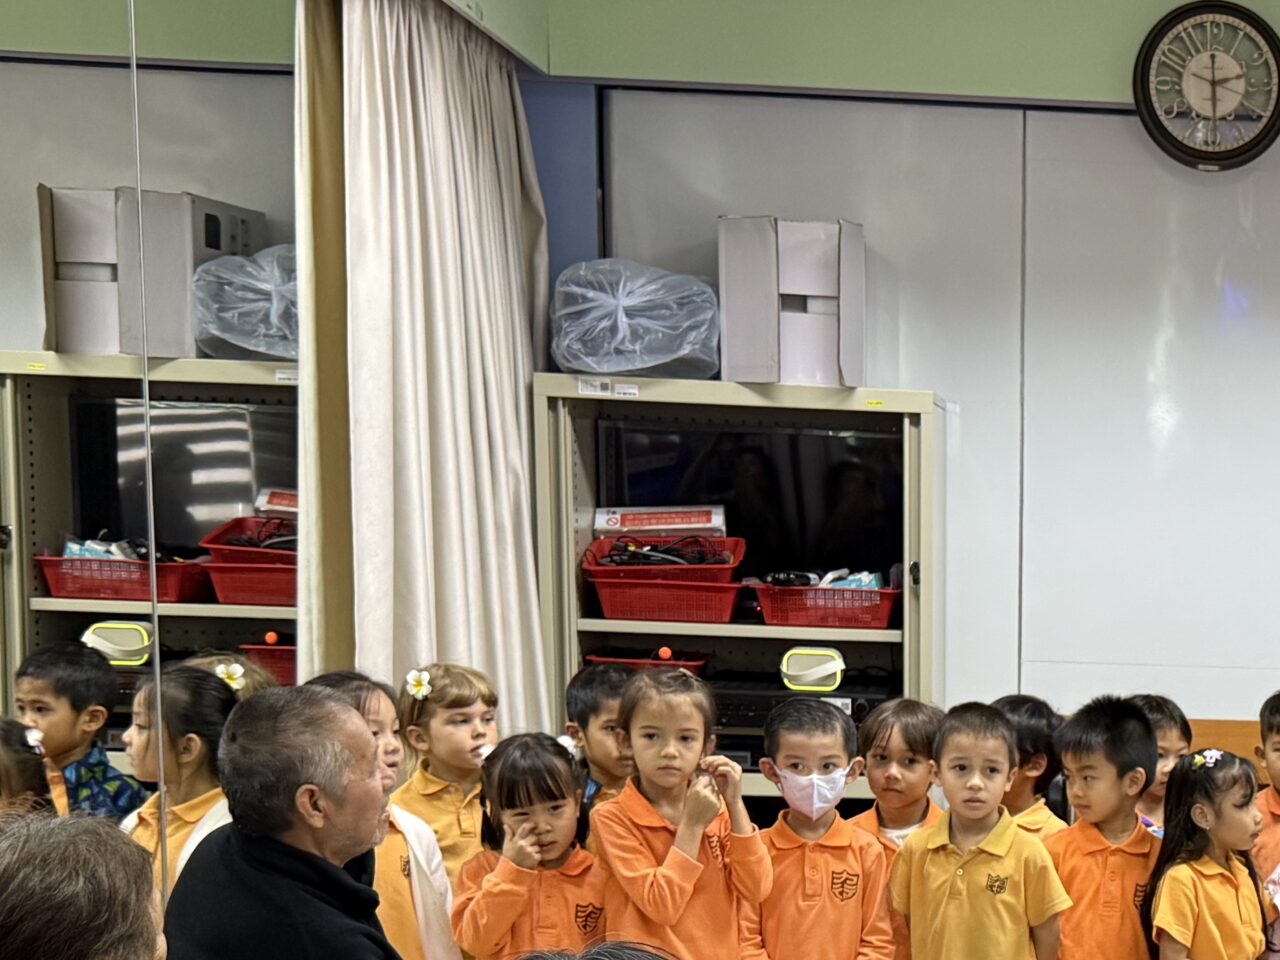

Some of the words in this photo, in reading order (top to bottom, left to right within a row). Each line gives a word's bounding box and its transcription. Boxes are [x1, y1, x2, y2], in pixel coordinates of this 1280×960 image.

[1203, 21, 1225, 51] 12
[1230, 29, 1245, 56] 1
[1162, 97, 1188, 119] 8
